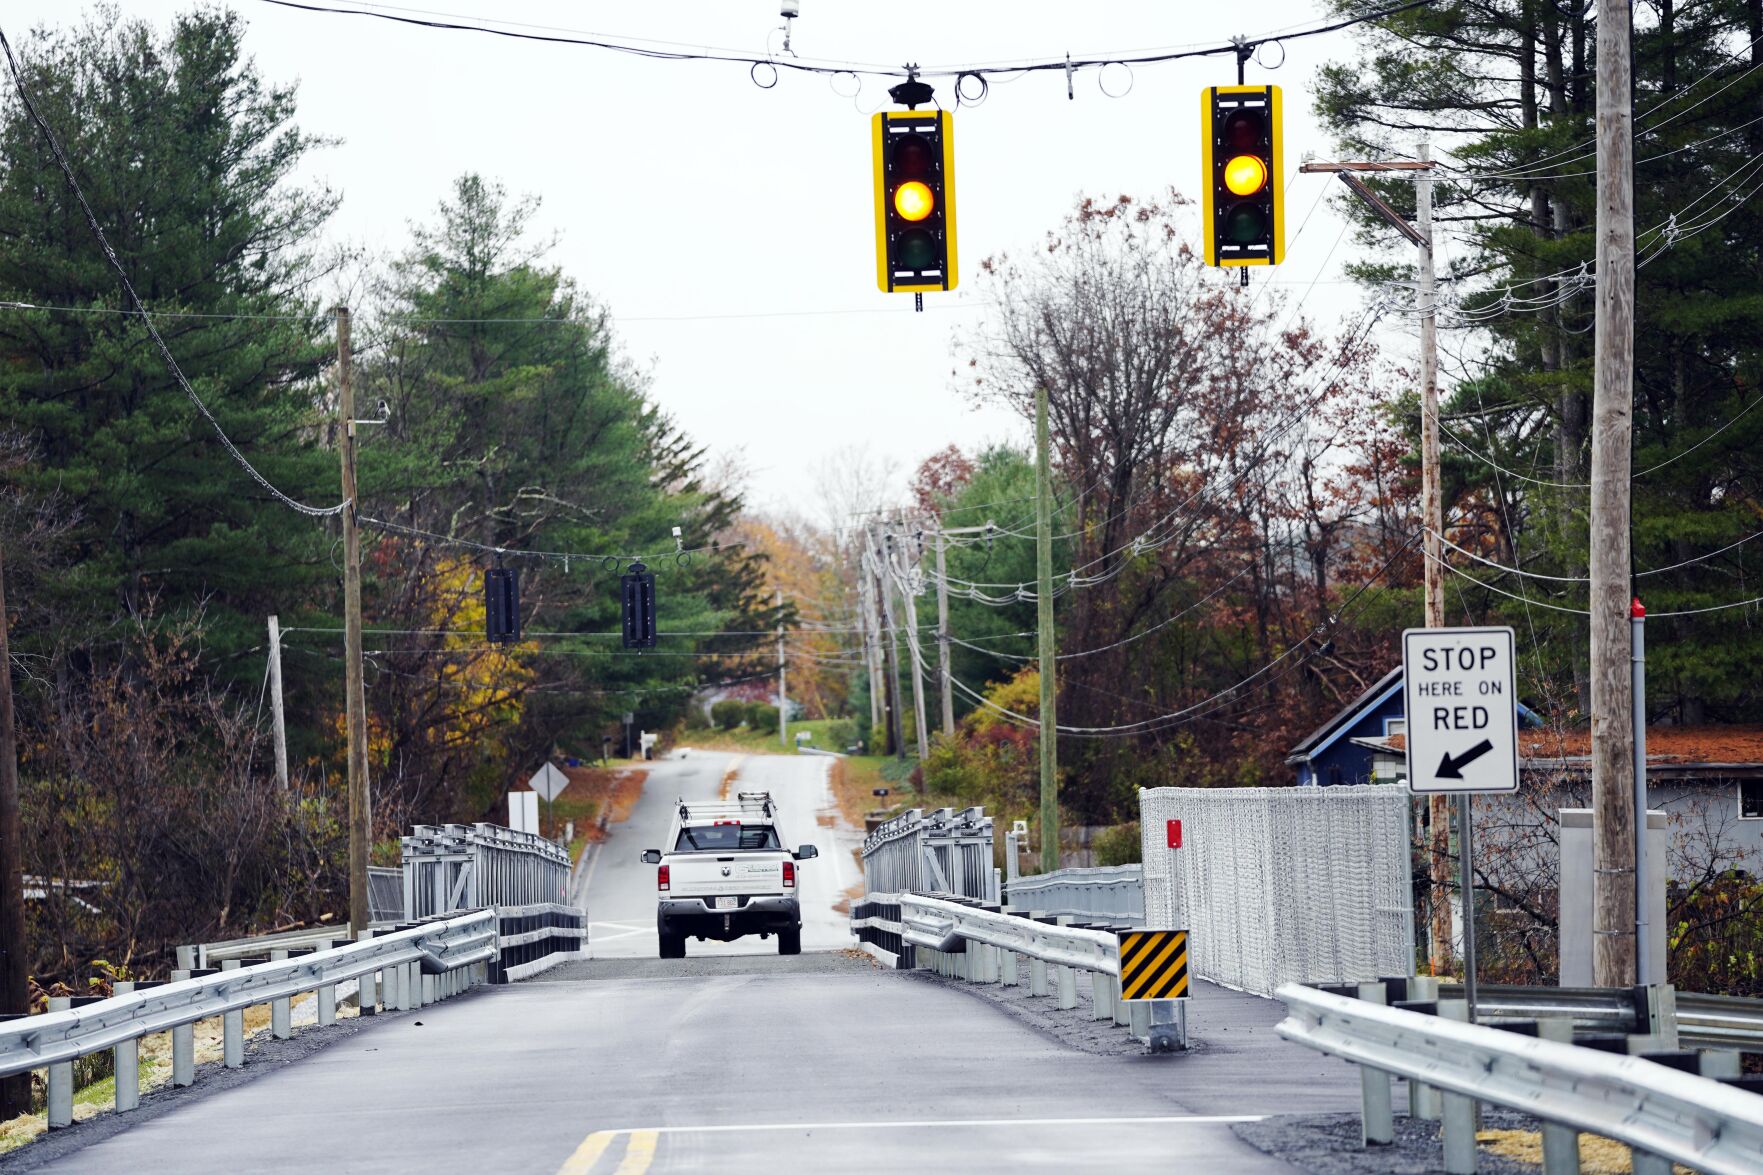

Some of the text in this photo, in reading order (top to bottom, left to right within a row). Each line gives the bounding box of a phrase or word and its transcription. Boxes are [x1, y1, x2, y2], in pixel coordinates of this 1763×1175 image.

[1423, 646, 1496, 672] STOP
[1418, 680, 1503, 697] HERE ON
[1433, 706, 1489, 731] RED
